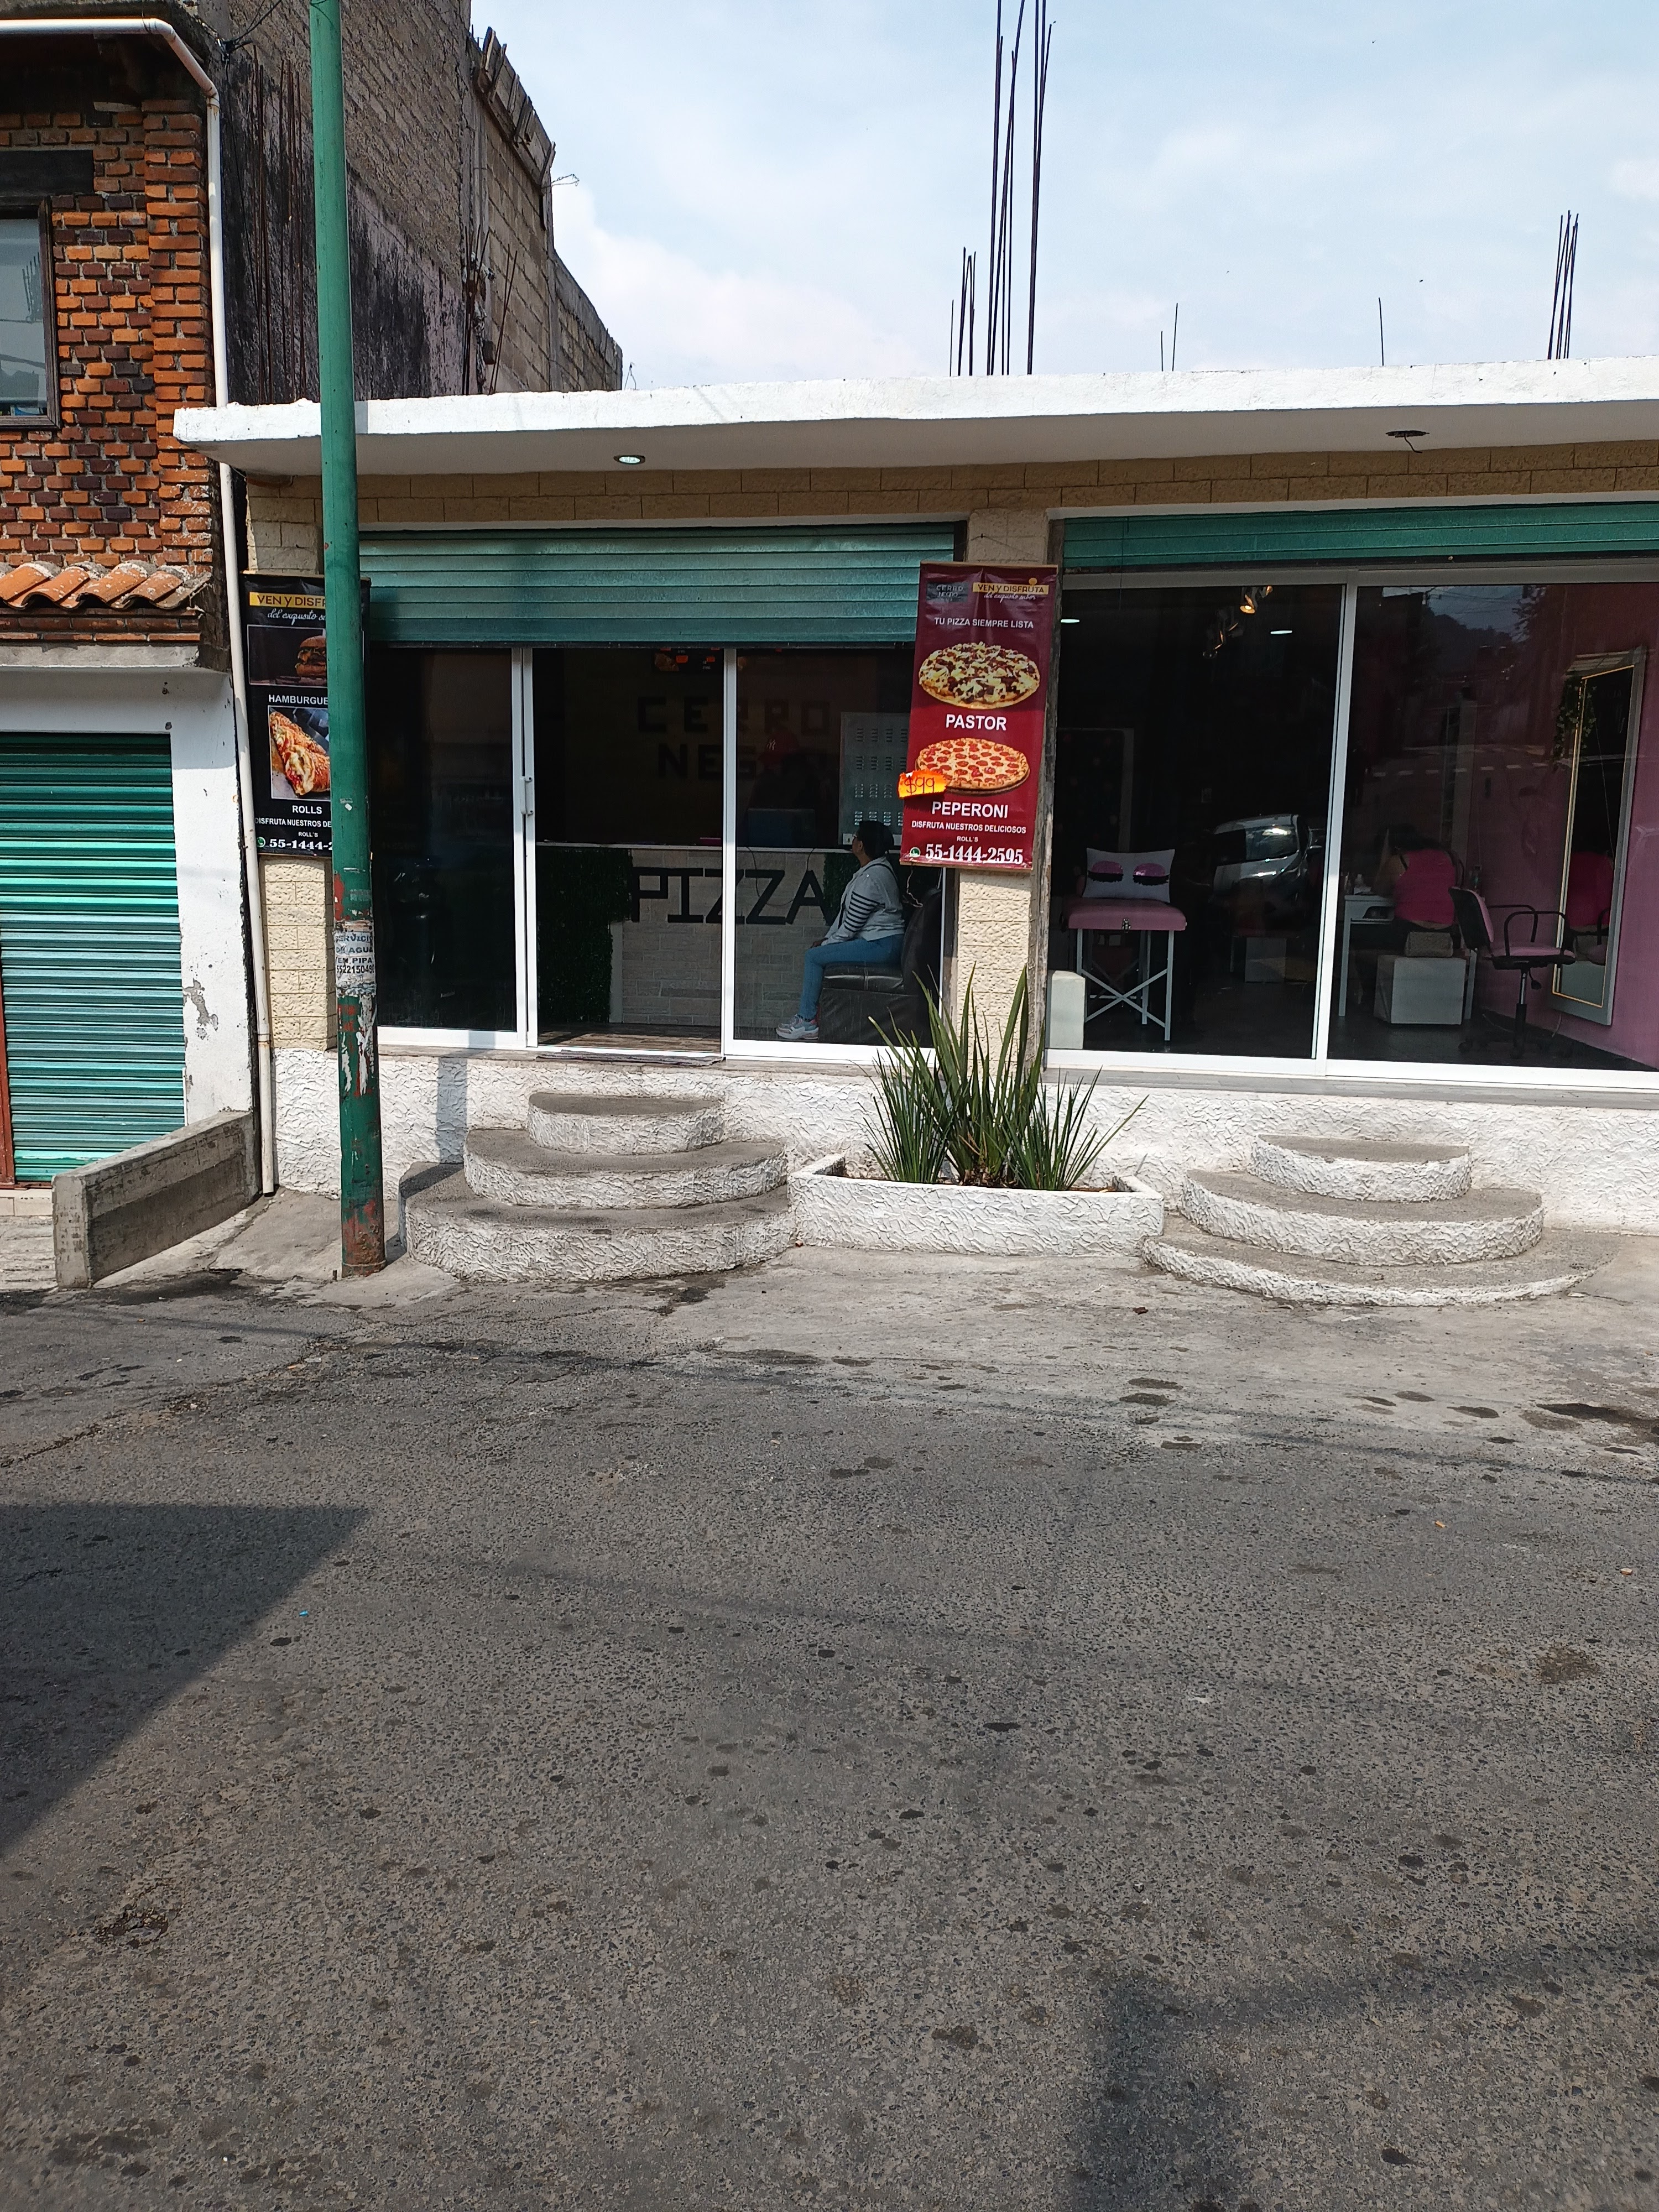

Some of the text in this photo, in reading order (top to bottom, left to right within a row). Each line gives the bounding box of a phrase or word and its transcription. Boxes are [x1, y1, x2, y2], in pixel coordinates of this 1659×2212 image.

[257, 594, 282, 604] VEN
[934, 617, 1034, 629] TU PIZZA SIEMPRE LISTA
[268, 694, 328, 705] HAMBURGUE
[946, 714, 1007, 731] PASTOR
[904, 775, 936, 795] $99
[292, 805, 322, 815] ROLLS
[932, 801, 1009, 818] PEPERONI
[255, 817, 286, 826] DISFRUTA
[287, 819, 321, 827] NUESTROS
[911, 820, 1026, 834] DISFRUTA NUESTROS DELICIOSOS
[925, 843, 1024, 865] 55-1444-2595
[630, 867, 827, 925] PIZZA
